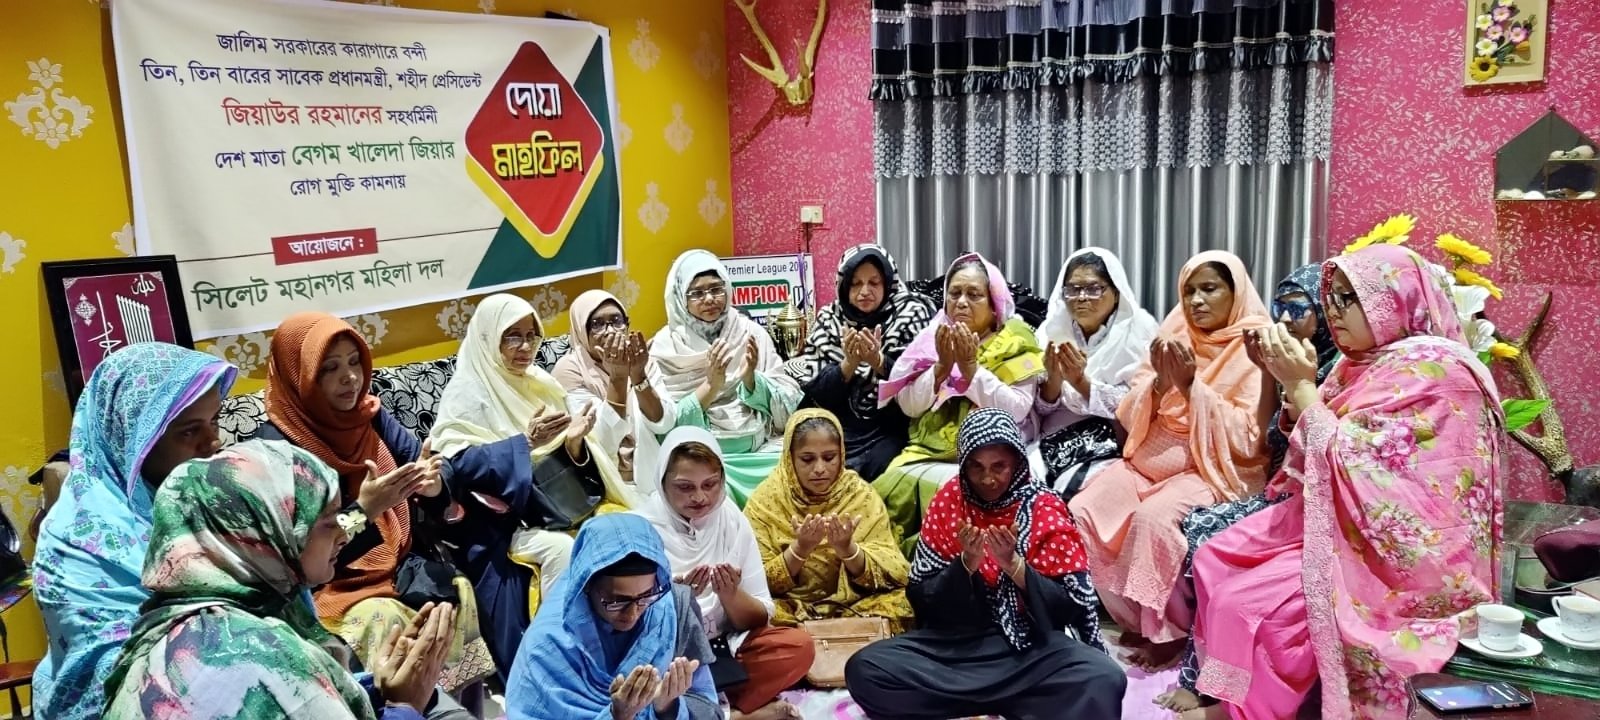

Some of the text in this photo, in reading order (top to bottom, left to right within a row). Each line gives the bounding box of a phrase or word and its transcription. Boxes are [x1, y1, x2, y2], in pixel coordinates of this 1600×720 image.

[216, 30, 427, 60] জালিম সরকারের কারাগারে বন্দী
[139, 58, 482, 90] তিন, তিন বারের সাবেক প্রধানমন্ত্রী, শহীদ প্রেসিডেন্ট
[221, 97, 438, 127] জিয়াউর রহমানের সহধর্মিনী
[506, 82, 562, 119] দোয়া
[215, 136, 455, 168] দেশ মাতা বেগম খালেদা জিয়ার
[491, 130, 584, 180] মাহফিল
[290, 173, 406, 197] রোগ মুক্তি কামনায়
[288, 236, 354, 256] আয়োজনে
[757, 263, 787, 275] League
[191, 259, 444, 312] সিলেট মহানগর মহিলা দল
